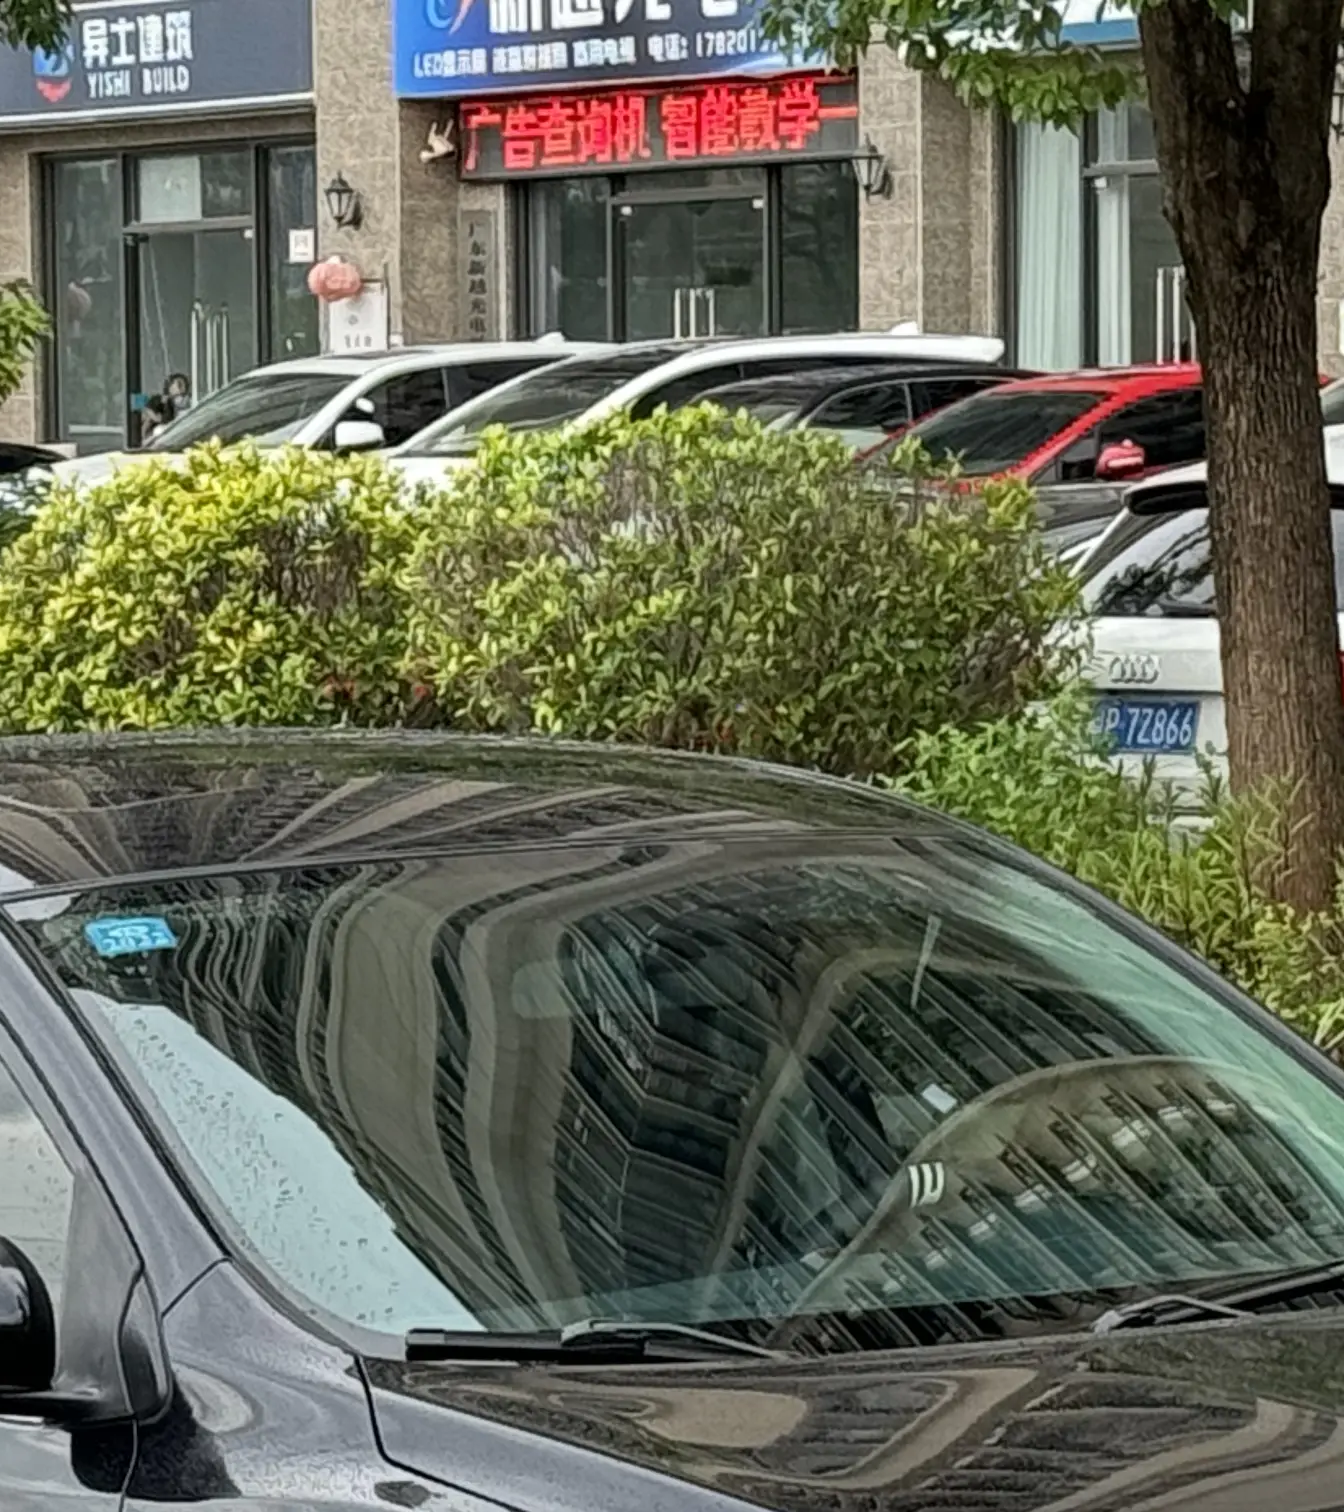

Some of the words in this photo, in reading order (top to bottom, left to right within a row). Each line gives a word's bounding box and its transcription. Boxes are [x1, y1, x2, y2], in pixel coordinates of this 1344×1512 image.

[87, 70, 131, 98] YISHI
[142, 65, 190, 95] BUILD
[464, 92, 652, 171] 广告查询机
